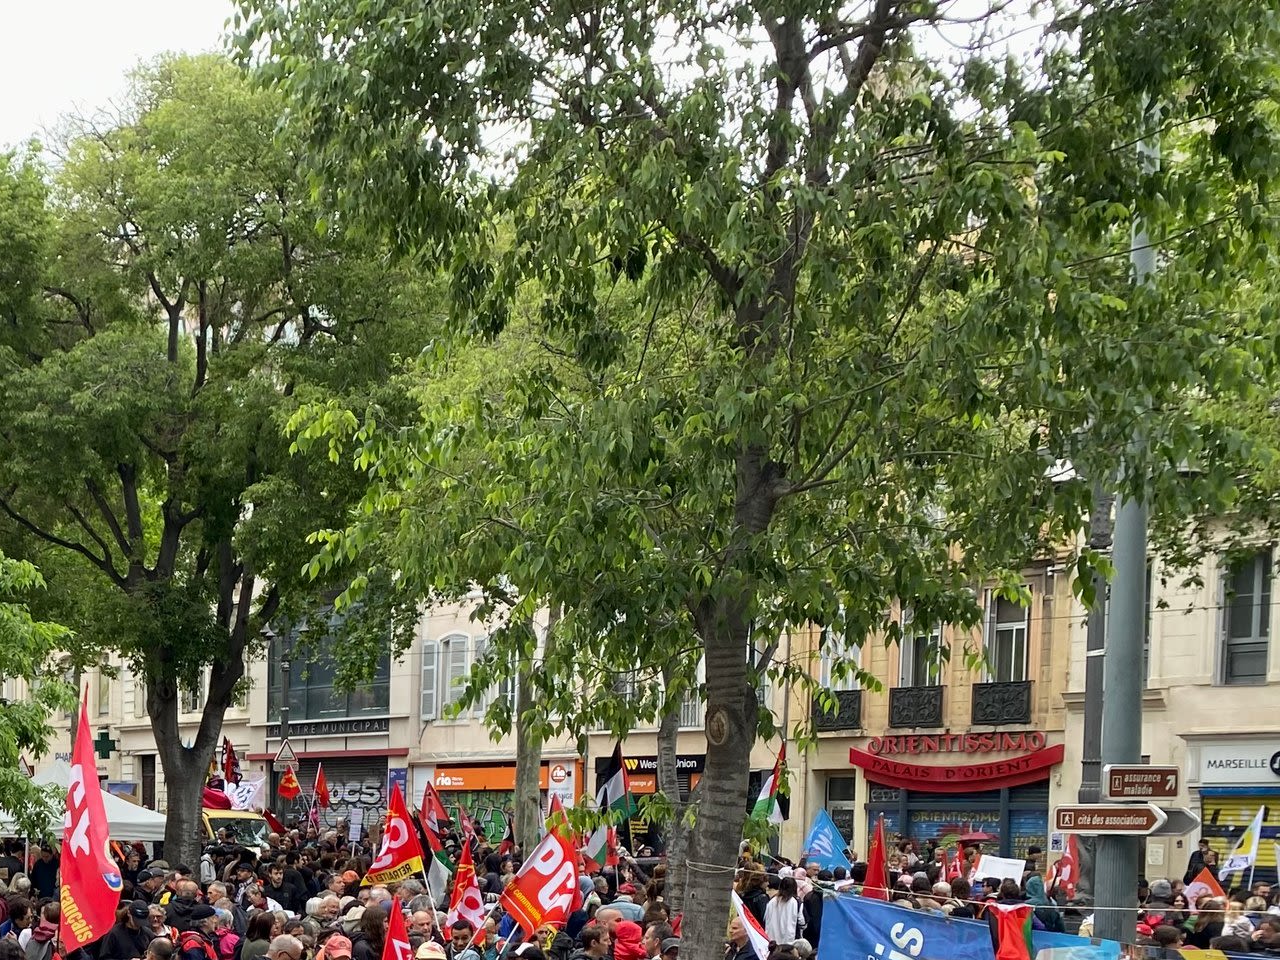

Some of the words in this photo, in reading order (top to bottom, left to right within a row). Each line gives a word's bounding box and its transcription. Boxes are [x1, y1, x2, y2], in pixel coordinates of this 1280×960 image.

[322, 720, 388, 734] MUNICIPAL
[867, 731, 1048, 756] ORIENTISSIMO
[872, 759, 931, 779] PALAIS
[945, 757, 1033, 779] D'ORIENT
[1206, 758, 1268, 770] MARSEILLE
[436, 772, 452, 786] ria
[1124, 773, 1161, 784] assurance
[1124, 784, 1153, 796] maladie
[1078, 813, 1091, 825] cité
[1092, 813, 1104, 825] des
[1105, 813, 1147, 826] associations
